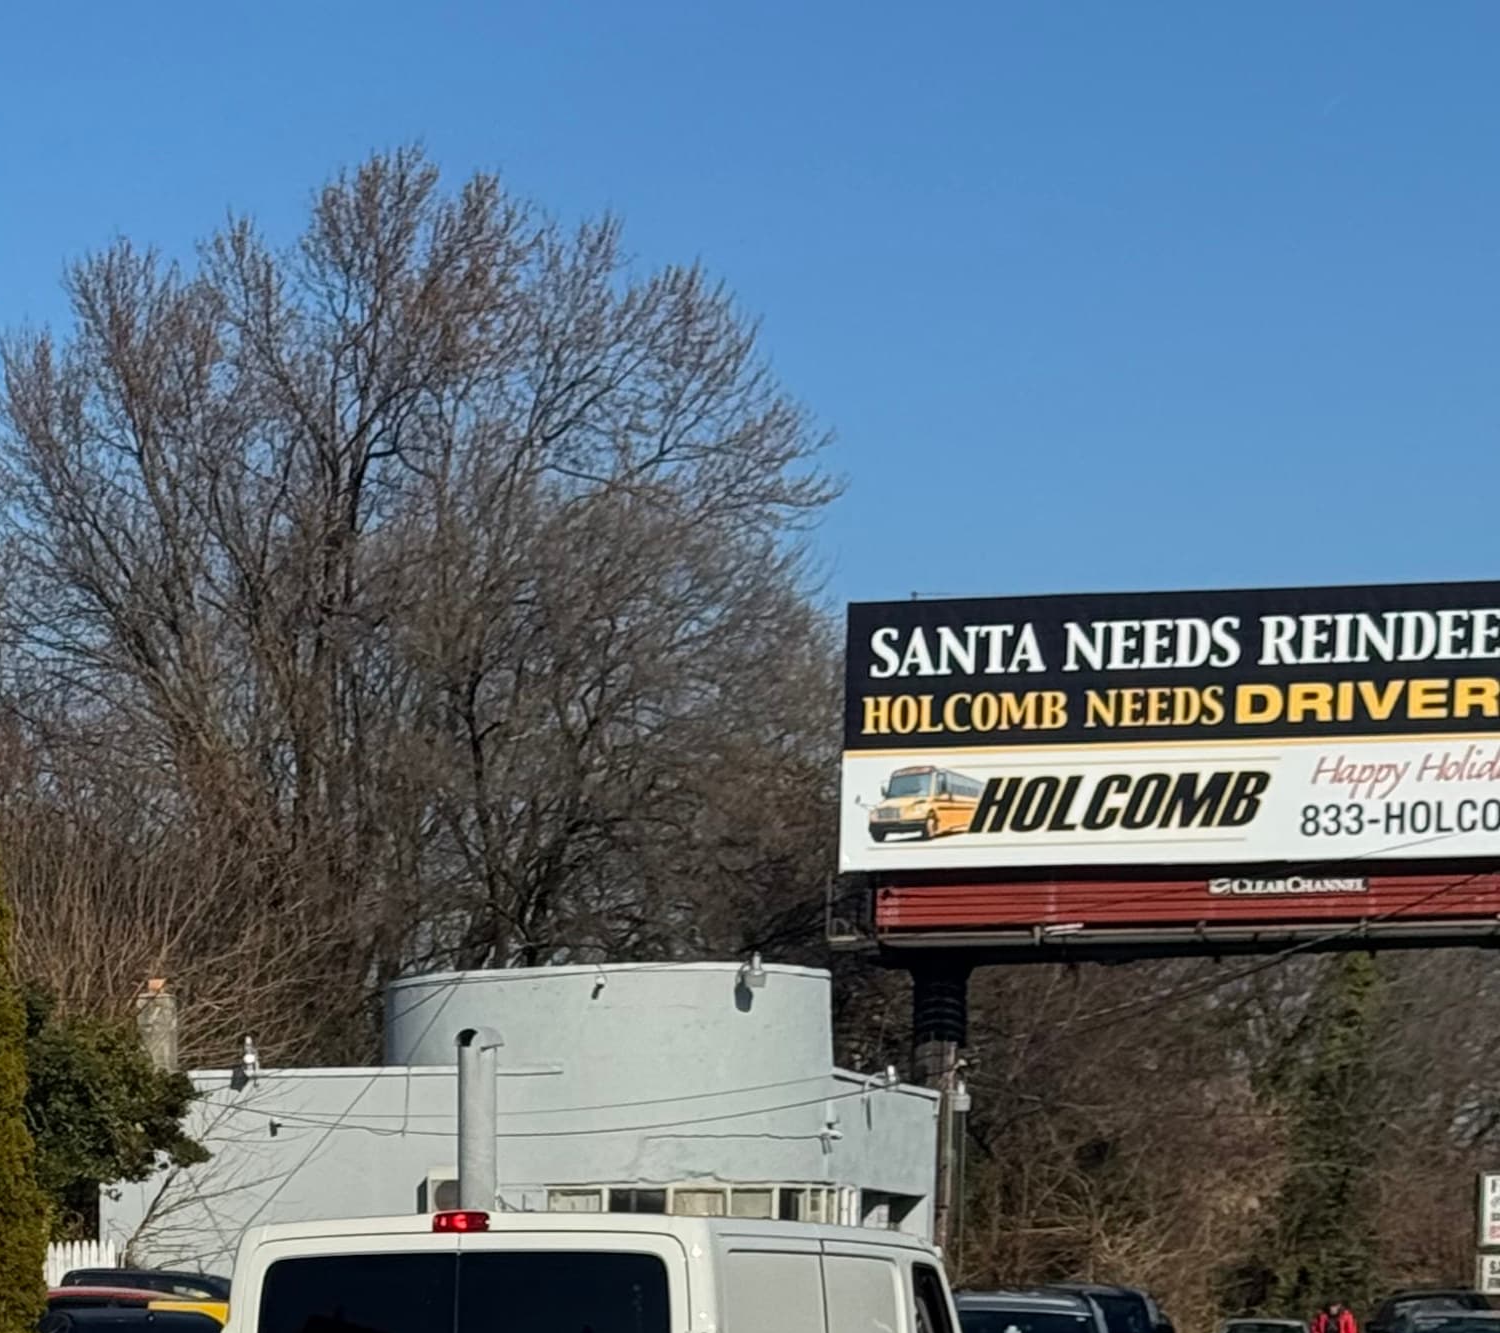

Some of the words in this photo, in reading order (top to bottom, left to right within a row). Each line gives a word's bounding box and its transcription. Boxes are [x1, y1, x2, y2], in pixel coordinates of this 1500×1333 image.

[870, 622, 1046, 678] SANTA
[1062, 616, 1241, 671] NEEDS
[1257, 608, 1500, 665] REINDEE
[861, 690, 1068, 735] HOLCOMB
[1084, 685, 1225, 728] NEEDS
[1235, 677, 1500, 724] DRIVER
[968, 770, 1271, 833] HOLCOMB
[1311, 755, 1411, 799] Happy
[1300, 798, 1500, 836] 833-HOLCO
